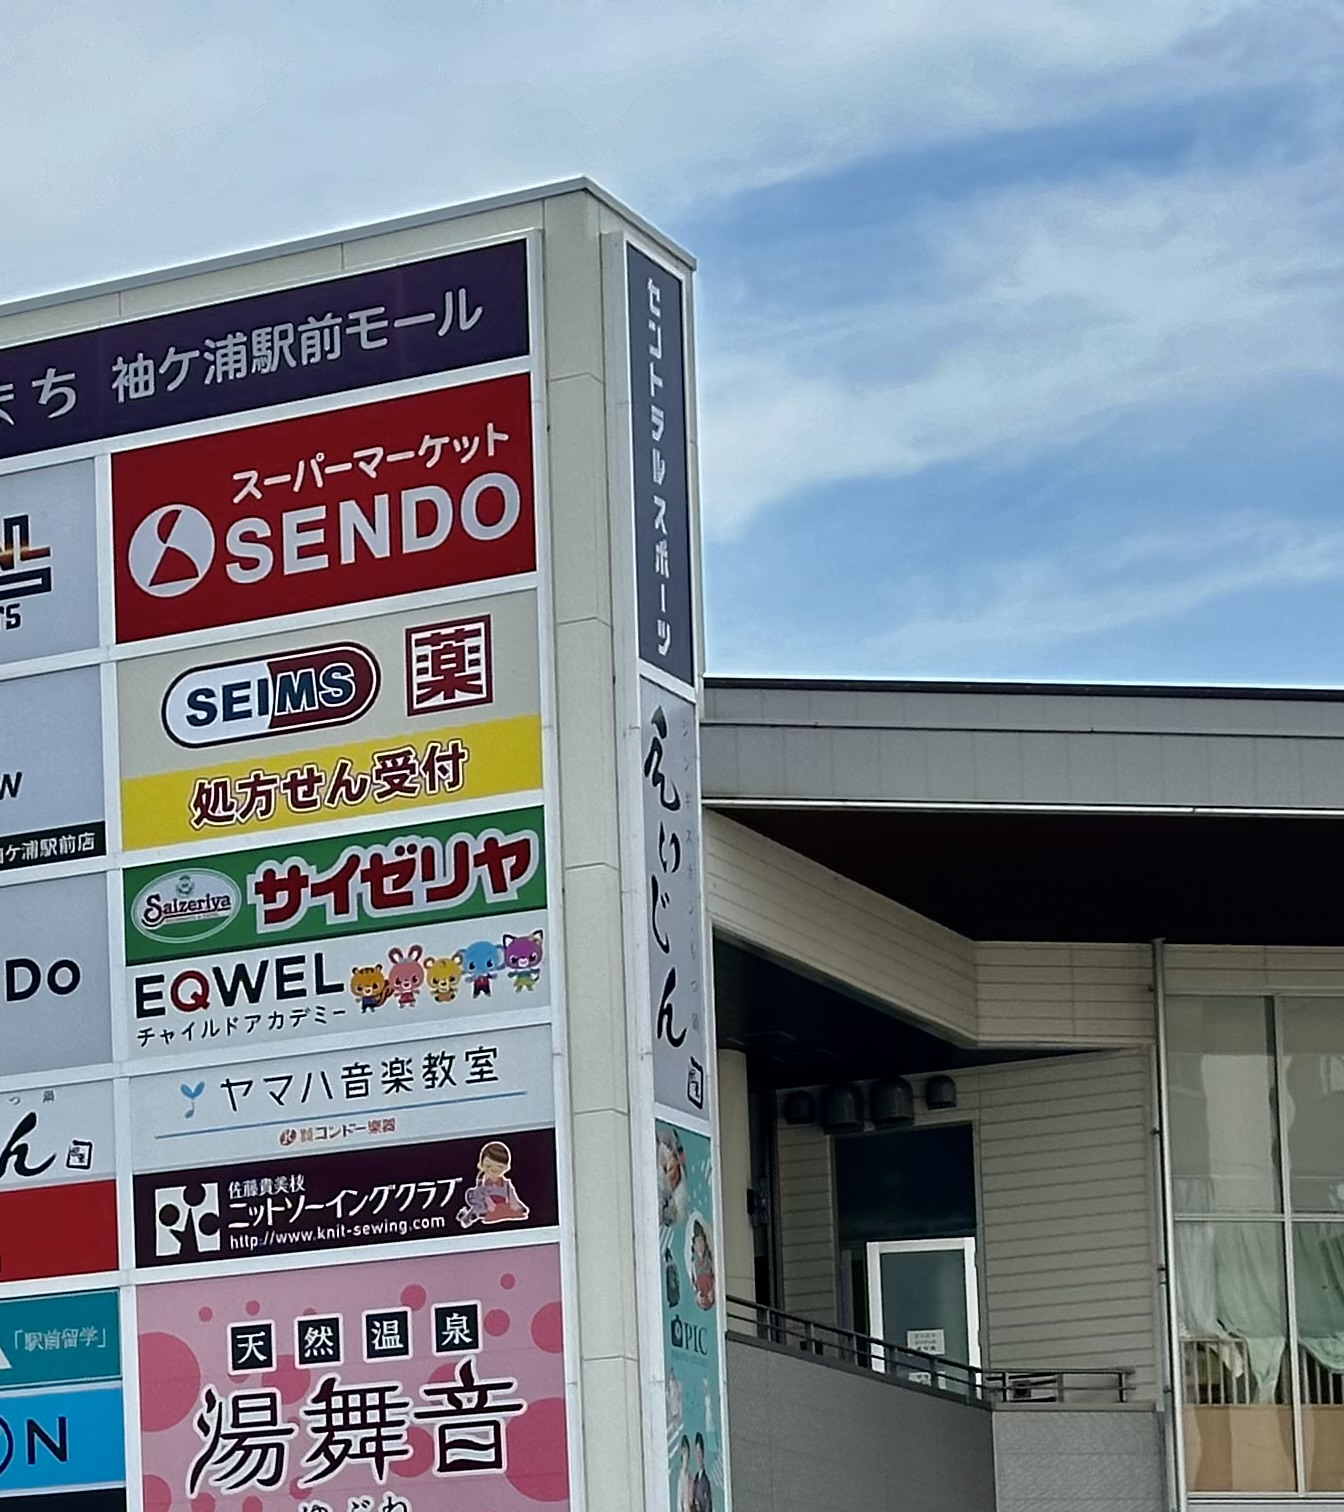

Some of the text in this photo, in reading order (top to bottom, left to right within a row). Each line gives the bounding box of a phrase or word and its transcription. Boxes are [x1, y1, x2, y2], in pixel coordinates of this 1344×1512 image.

[112, 288, 483, 403] 袖ケ浦駅前モール
[232, 422, 509, 504] スーパーマーケット
[225, 472, 521, 584] SENDO
[185, 662, 357, 728] SEIMS
[414, 626, 485, 704] 薬
[192, 742, 468, 826] 処方せん受付
[143, 893, 231, 925] Saizeriya
[253, 834, 533, 926] サイゼリヤ
[644, 705, 687, 1048] えいじん
[136, 952, 345, 1019] EQWEL
[137, 1005, 346, 1047] チャイルドアカデミー
[220, 1047, 500, 1112] ヤマハ音楽教室
[230, 1215, 445, 1251] http://www.knit-sewing.com
[234, 1311, 476, 1366] 天然温泉
[189, 1359, 526, 1496] 湯舞音
